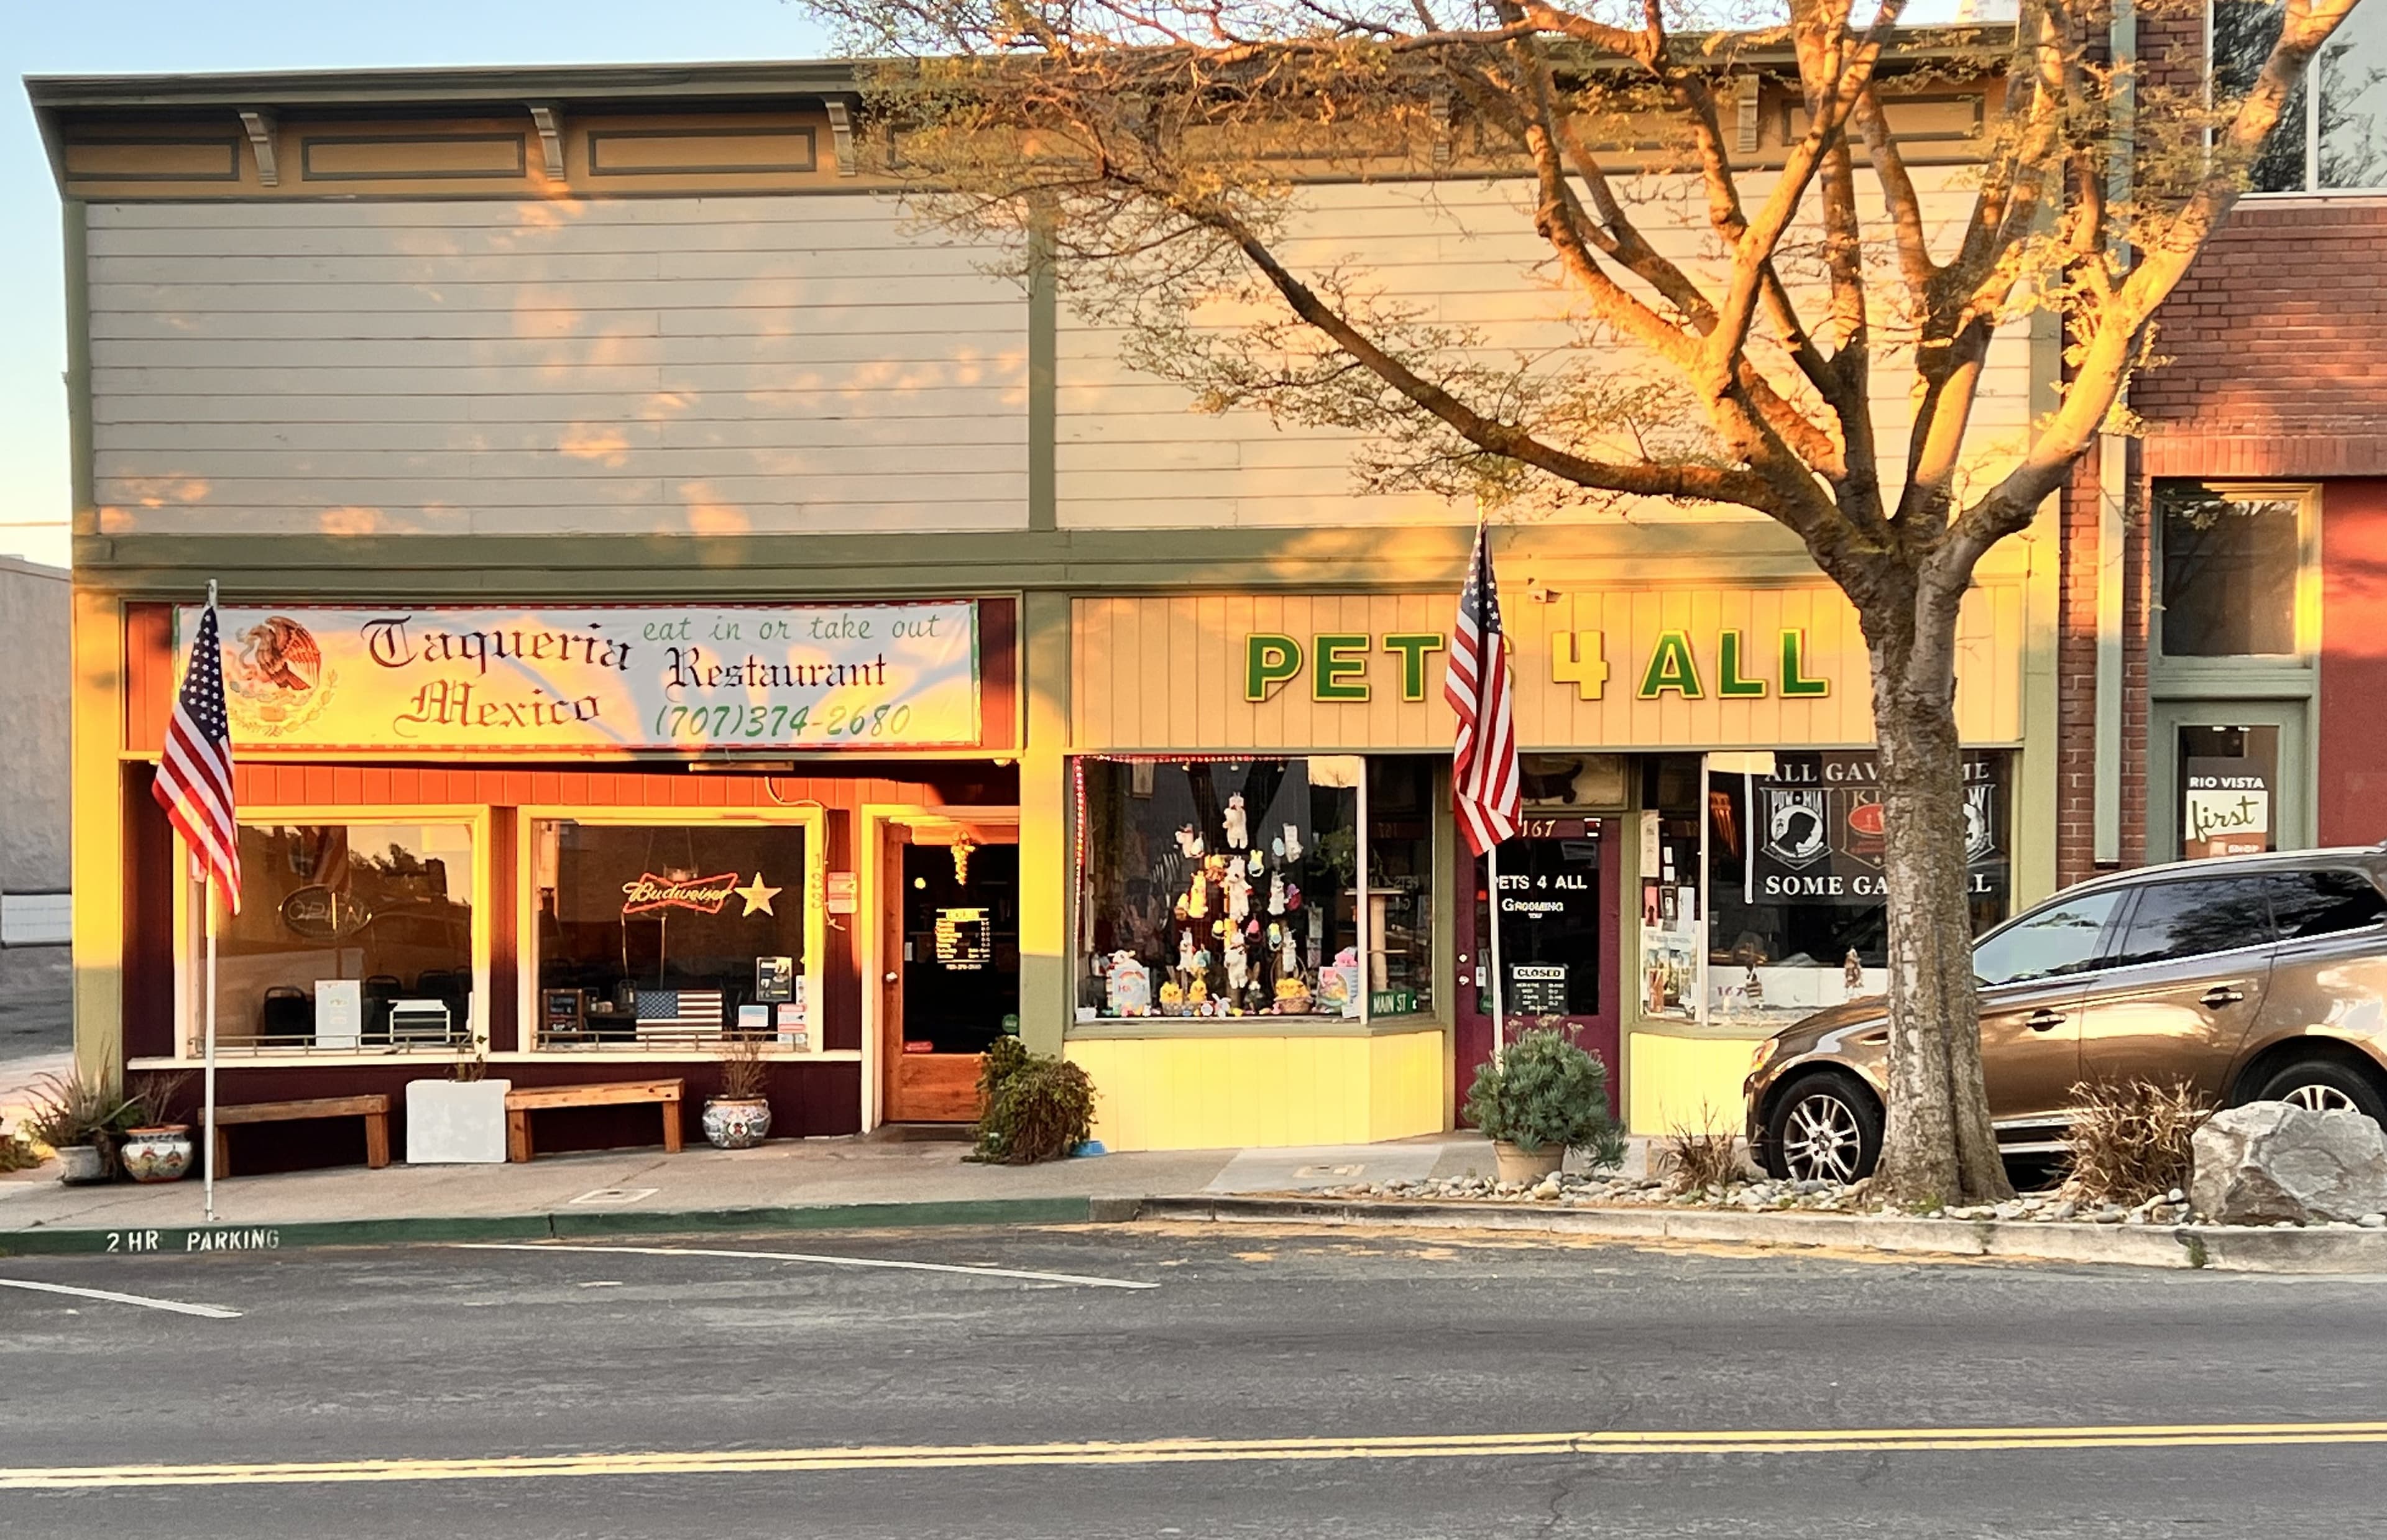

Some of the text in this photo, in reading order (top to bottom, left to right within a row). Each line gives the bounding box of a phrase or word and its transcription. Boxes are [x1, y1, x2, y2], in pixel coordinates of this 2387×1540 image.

[643, 612, 941, 641] eat in or take out
[361, 614, 633, 675] Taqueria
[664, 645, 888, 704] Restaurant
[1244, 628, 1830, 702] PET 4 ALL
[393, 677, 600, 738] Mexico
[655, 703, 911, 738] (707)374-2680
[1826, 762, 1881, 781] GAV
[2189, 777, 2265, 789] RIO VISTA
[1852, 791, 1881, 809] KI
[1522, 820, 1556, 837] 167
[2192, 795, 2259, 843] first
[622, 882, 733, 902] Budweiser
[1537, 875, 1547, 889] 4
[1555, 875, 1588, 889] ALL
[1765, 875, 1888, 896] SOME GA
[1517, 968, 1561, 978] CLOSED
[1373, 993, 1407, 1014] MAIN ST
[106, 1229, 279, 1253] 2 HR PARKING
